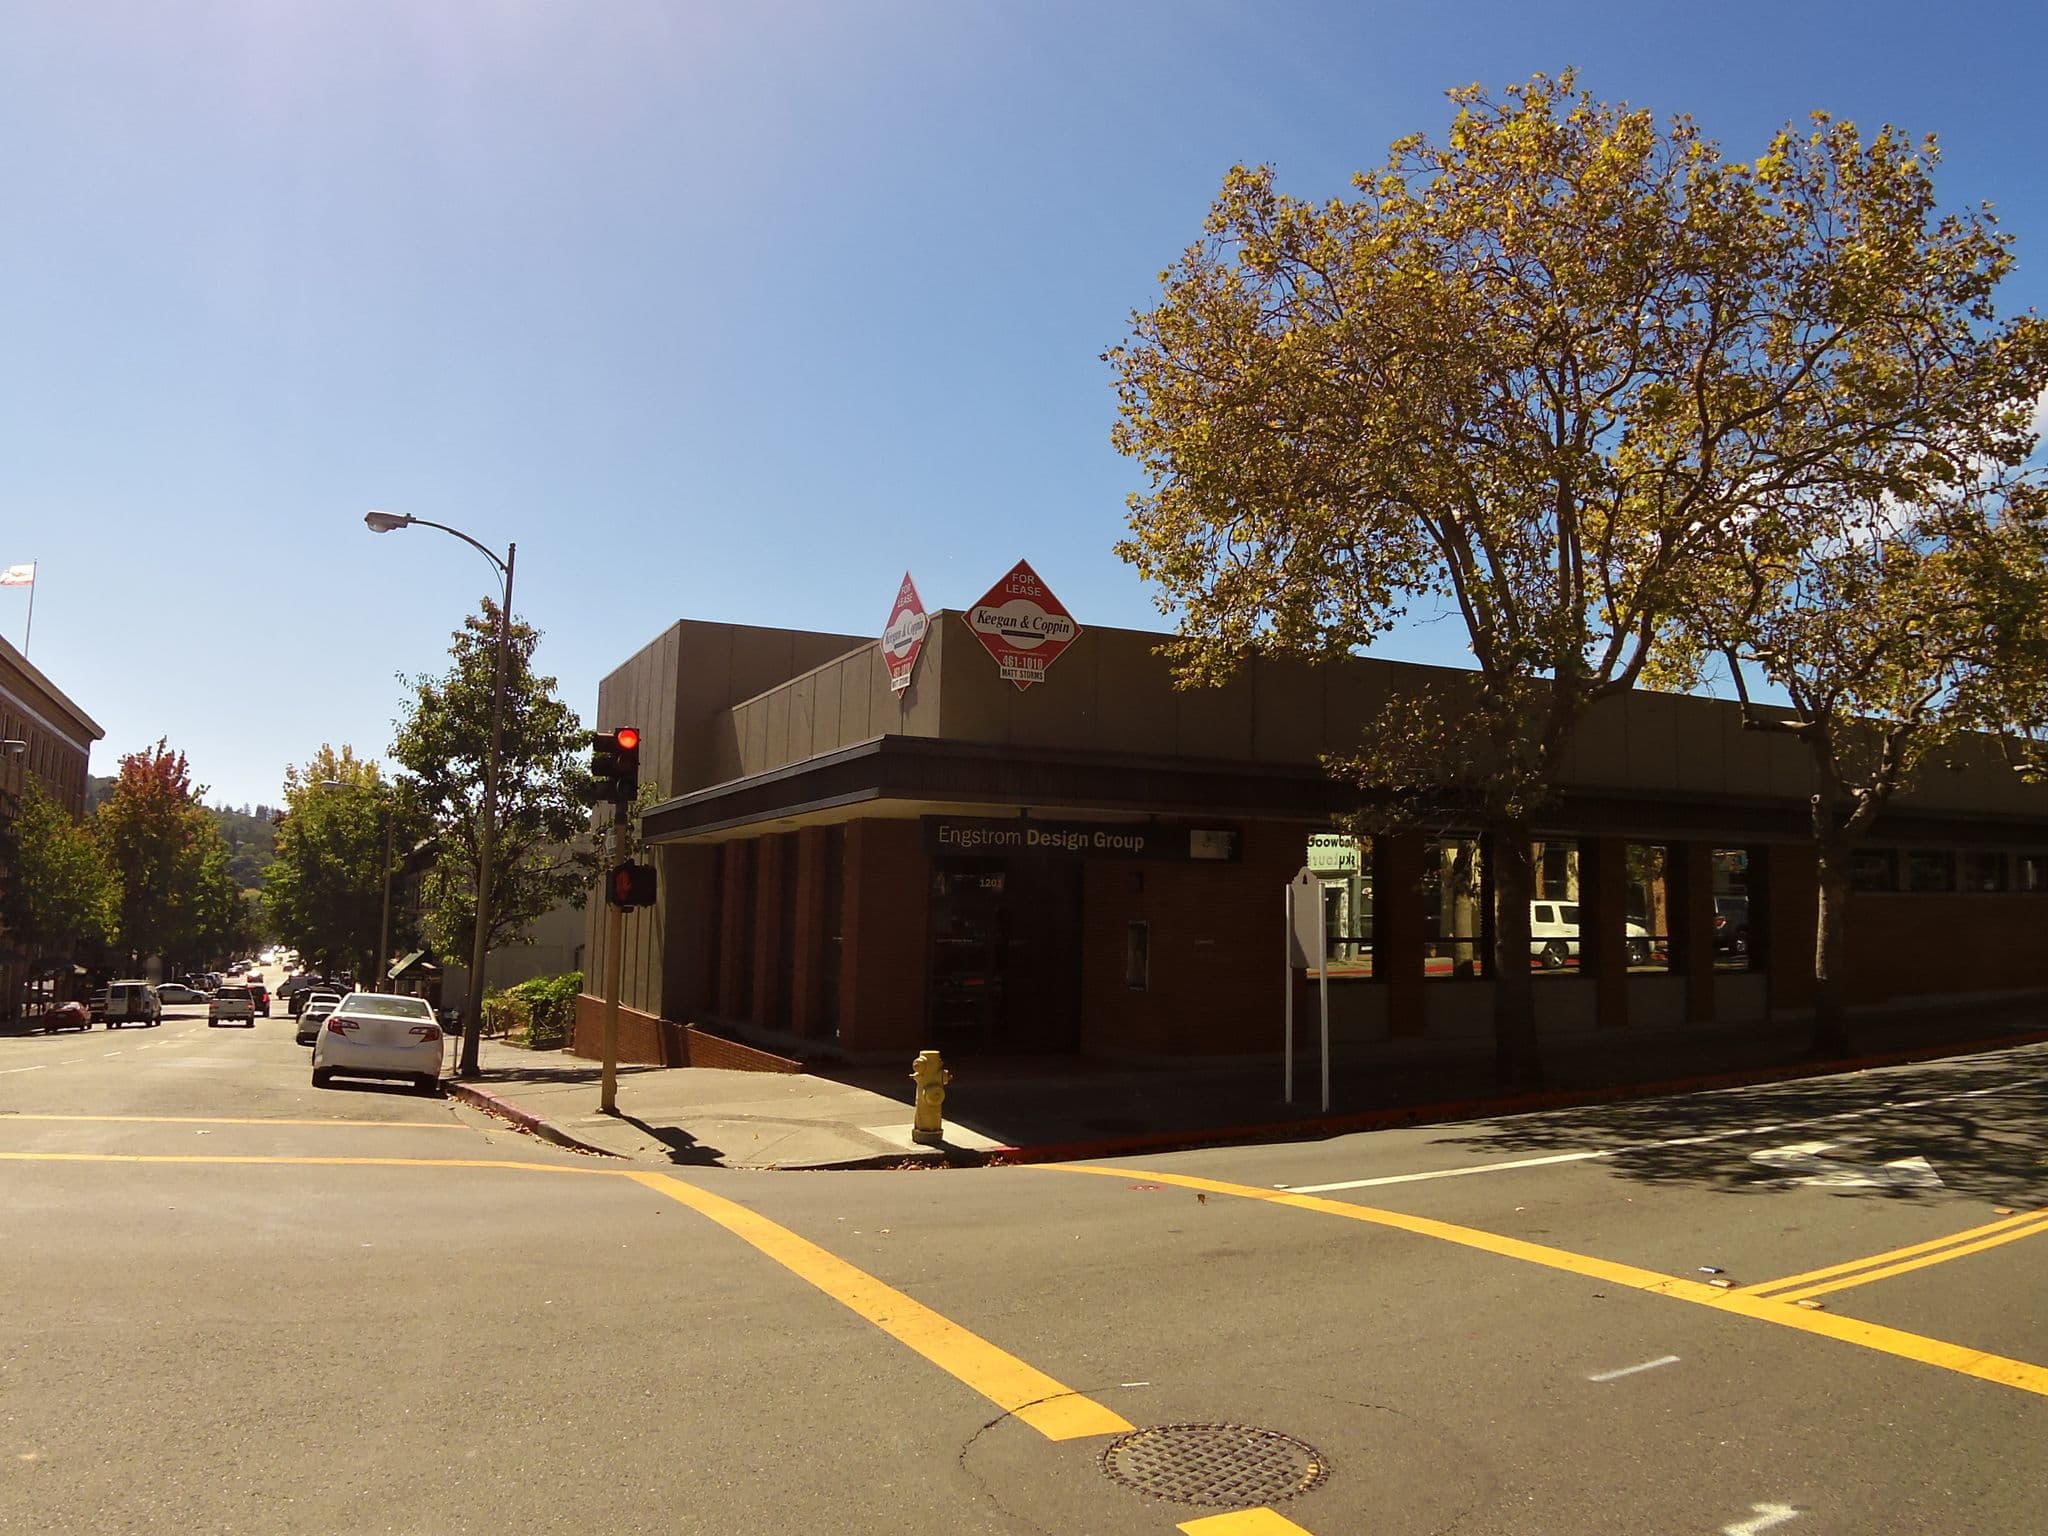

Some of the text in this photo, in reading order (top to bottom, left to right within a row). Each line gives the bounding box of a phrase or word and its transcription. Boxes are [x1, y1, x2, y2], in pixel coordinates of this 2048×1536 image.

[1012, 574, 1035, 585] FOR
[901, 583, 912, 594] FOR
[1006, 584, 1042, 597] LEASE
[897, 593, 913, 608] LEASE
[976, 610, 1070, 635] Keegan & Coppin
[1002, 655, 1043, 670] 461-1010
[1002, 667, 1018, 678] MATT
[938, 826, 1145, 852] Engstrom Design Group
